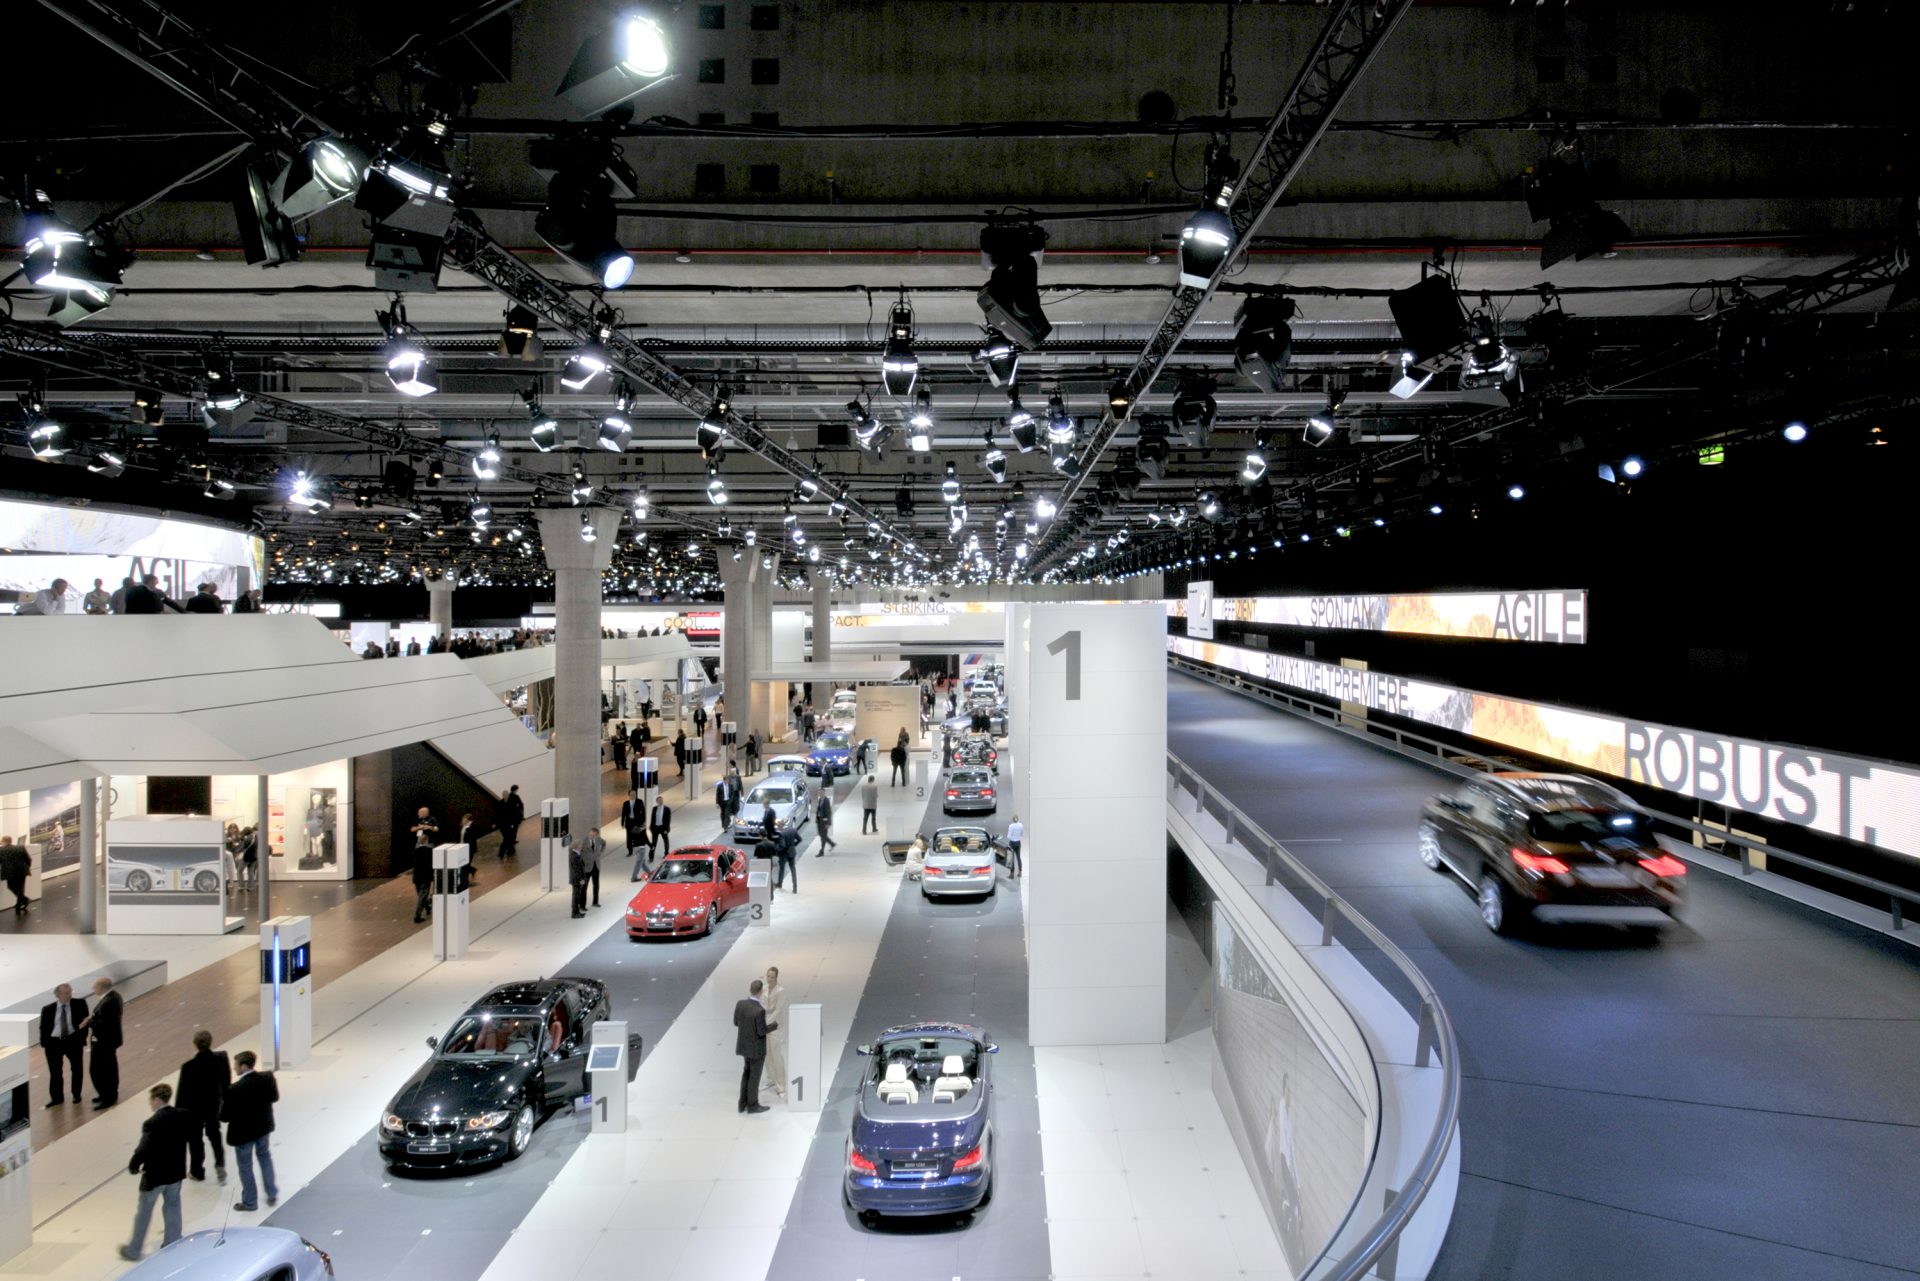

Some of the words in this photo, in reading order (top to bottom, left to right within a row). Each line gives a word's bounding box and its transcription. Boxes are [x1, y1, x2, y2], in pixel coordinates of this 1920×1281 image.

[1492, 589, 1583, 644] AGILE
[1046, 630, 1081, 701] 1
[1266, 654, 1287, 684] BMW
[867, 760, 874, 769] 5
[916, 786, 924, 797] 3
[751, 903, 763, 920] 3
[791, 1076, 803, 1101] 1
[595, 1096, 608, 1122] 1
